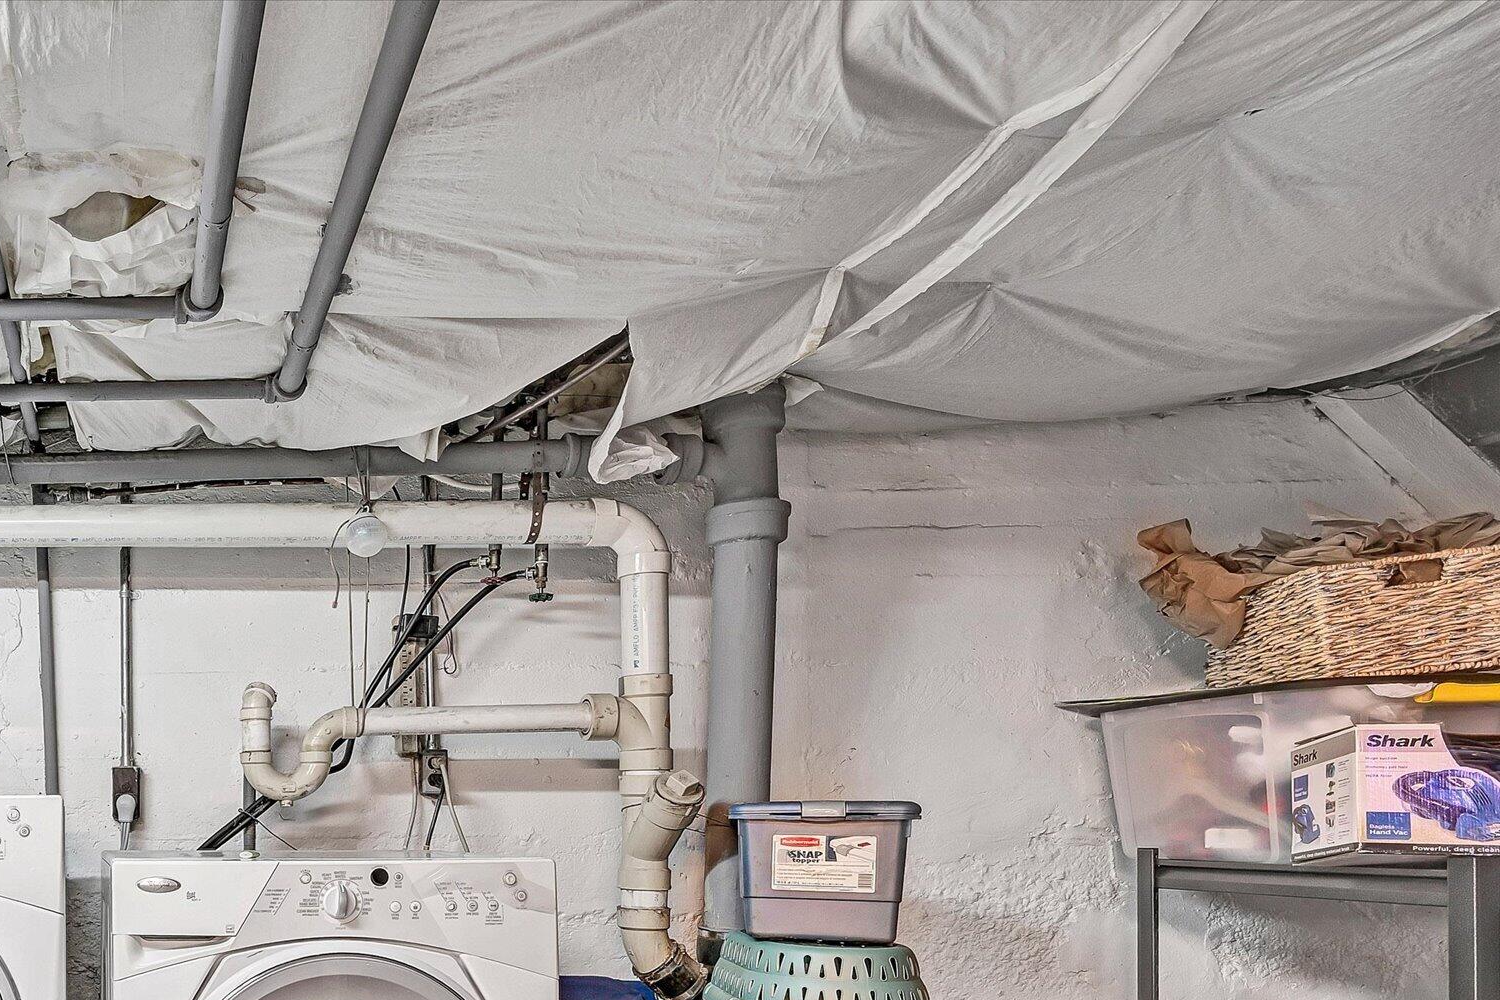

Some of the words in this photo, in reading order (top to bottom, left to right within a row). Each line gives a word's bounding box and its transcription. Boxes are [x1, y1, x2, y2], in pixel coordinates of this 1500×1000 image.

[1366, 734, 1435, 748] Shark
[1293, 749, 1318, 767] Shark
[788, 850, 823, 858] SNAP
[1454, 846, 1475, 854] deep
